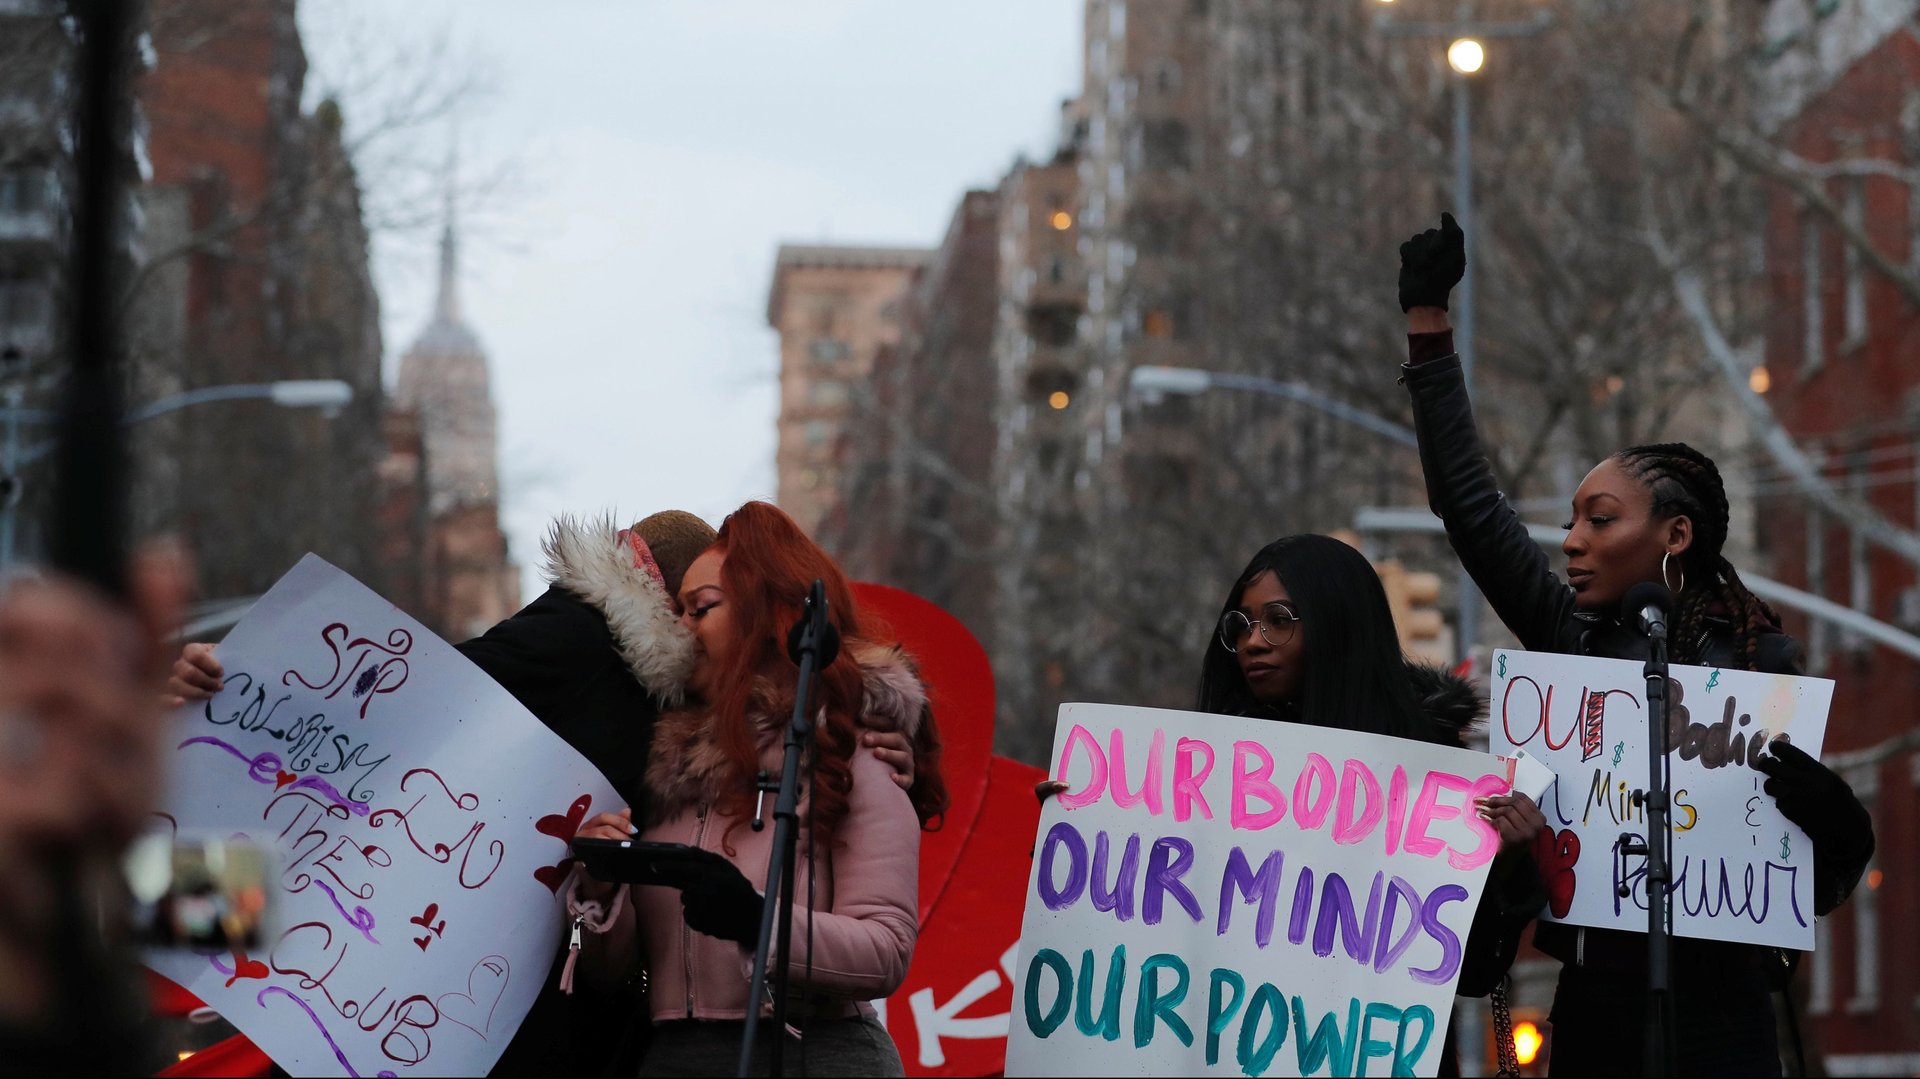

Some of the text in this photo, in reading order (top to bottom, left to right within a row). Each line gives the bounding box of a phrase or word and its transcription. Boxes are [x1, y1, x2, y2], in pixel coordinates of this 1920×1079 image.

[1057, 724, 1214, 822] OUR
[1231, 739, 1512, 871] BODIES
[1582, 768, 1698, 832] Mins
[1038, 822, 1204, 925] OUR
[1217, 846, 1469, 986] MINDS
[271, 921, 439, 1066] CLUB
[1024, 943, 1435, 1077] OUR POWER
